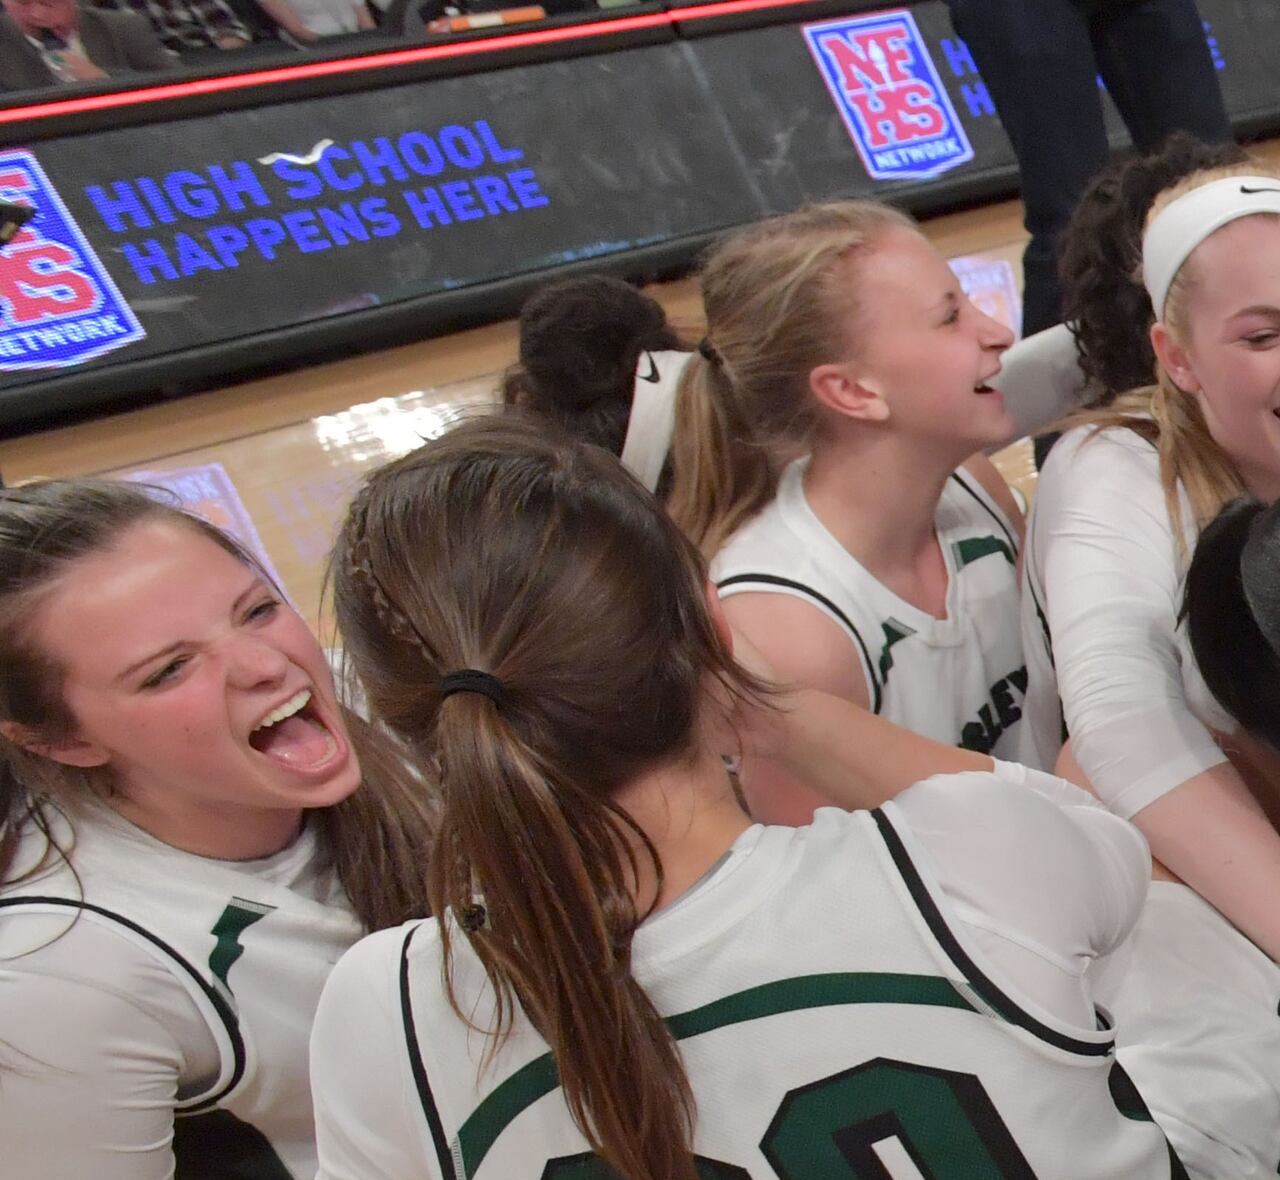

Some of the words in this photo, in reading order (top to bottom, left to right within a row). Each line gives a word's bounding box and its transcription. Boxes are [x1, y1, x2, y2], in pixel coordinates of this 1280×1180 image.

[85, 161, 271, 232] HIGH
[272, 120, 524, 199] SCHOOL
[873, 138, 963, 169] NETWORK
[122, 197, 402, 284] HAPPENS
[402, 168, 550, 229] HERE
[0, 315, 128, 357] ETWORK
